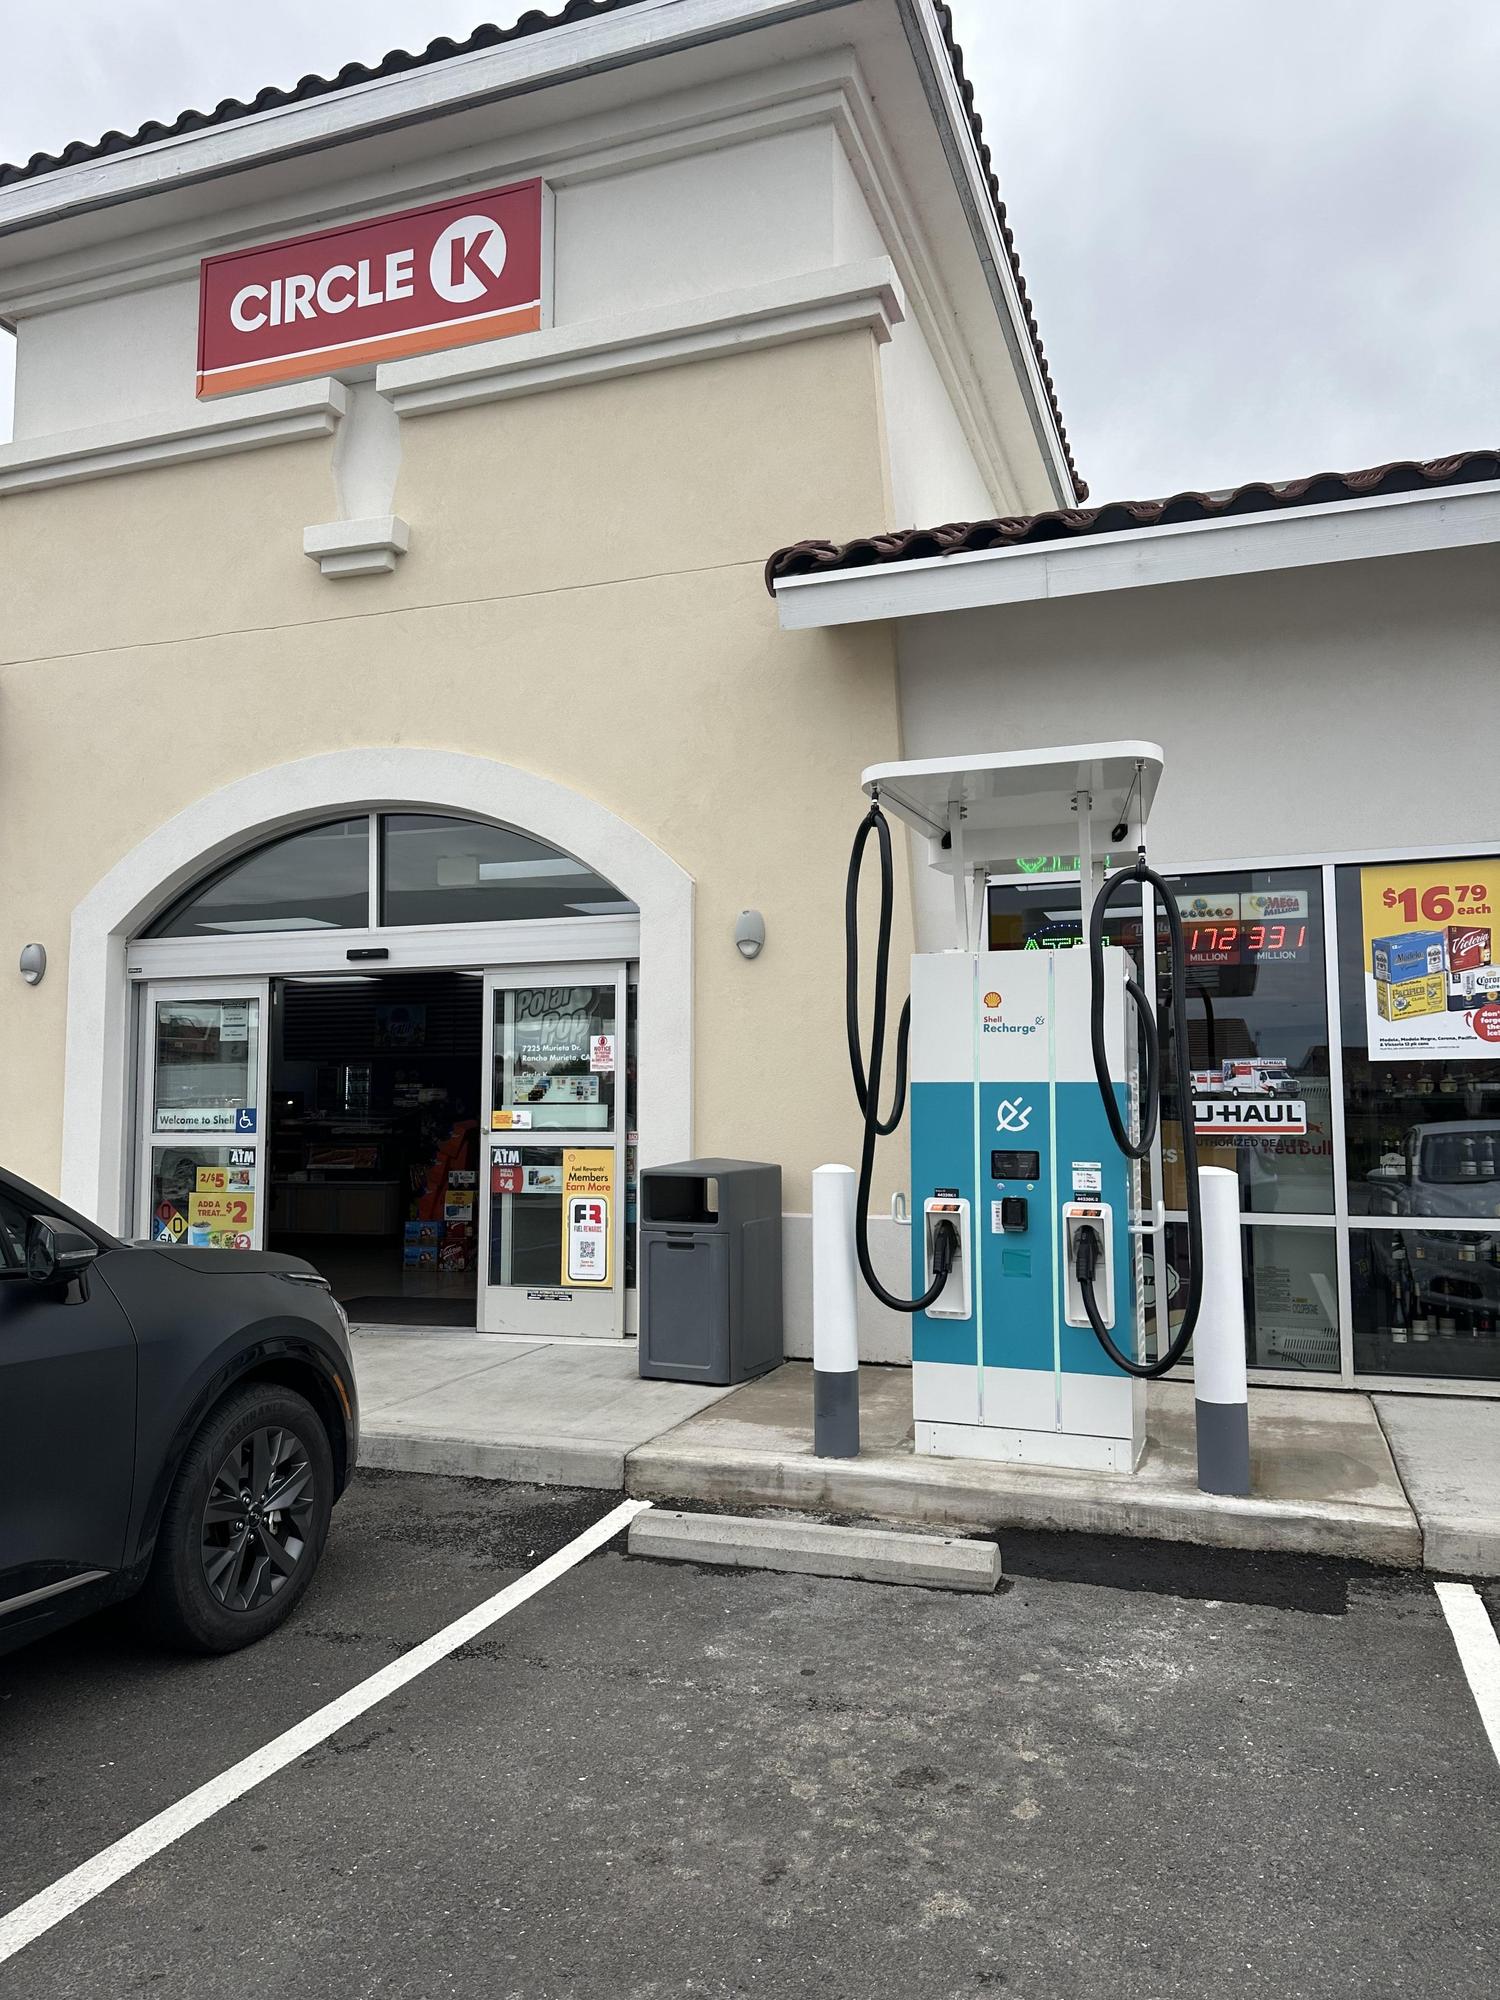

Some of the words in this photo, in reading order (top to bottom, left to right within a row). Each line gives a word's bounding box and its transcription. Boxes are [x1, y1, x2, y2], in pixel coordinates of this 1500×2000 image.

[230, 248, 415, 333] CIRCLE
[1267, 896, 1300, 908] MEGA
[1457, 903, 1492, 915] each
[1190, 927, 1238, 951] 172
[1248, 925, 1306, 950] 331
[1189, 952, 1228, 962] MILLION
[1256, 951, 1296, 960] MILLION
[983, 1023, 1036, 1034] Recharge
[1193, 1104, 1302, 1122] U-HAUL
[160, 1116, 199, 1124] Welcome
[201, 1116, 210, 1124] to
[213, 1115, 234, 1124] Shell
[1196, 1138, 1259, 1147] UTHORIZED
[231, 1149, 254, 1163] ATM
[494, 1150, 520, 1163] ATM
[200, 1173, 224, 1188] 2/$5
[568, 1173, 609, 1182] Members
[500, 1178, 514, 1190] $4
[566, 1182, 585, 1191] Earn
[587, 1182, 611, 1191] More
[226, 1200, 248, 1223] $2
[173, 1217, 182, 1233] 0
